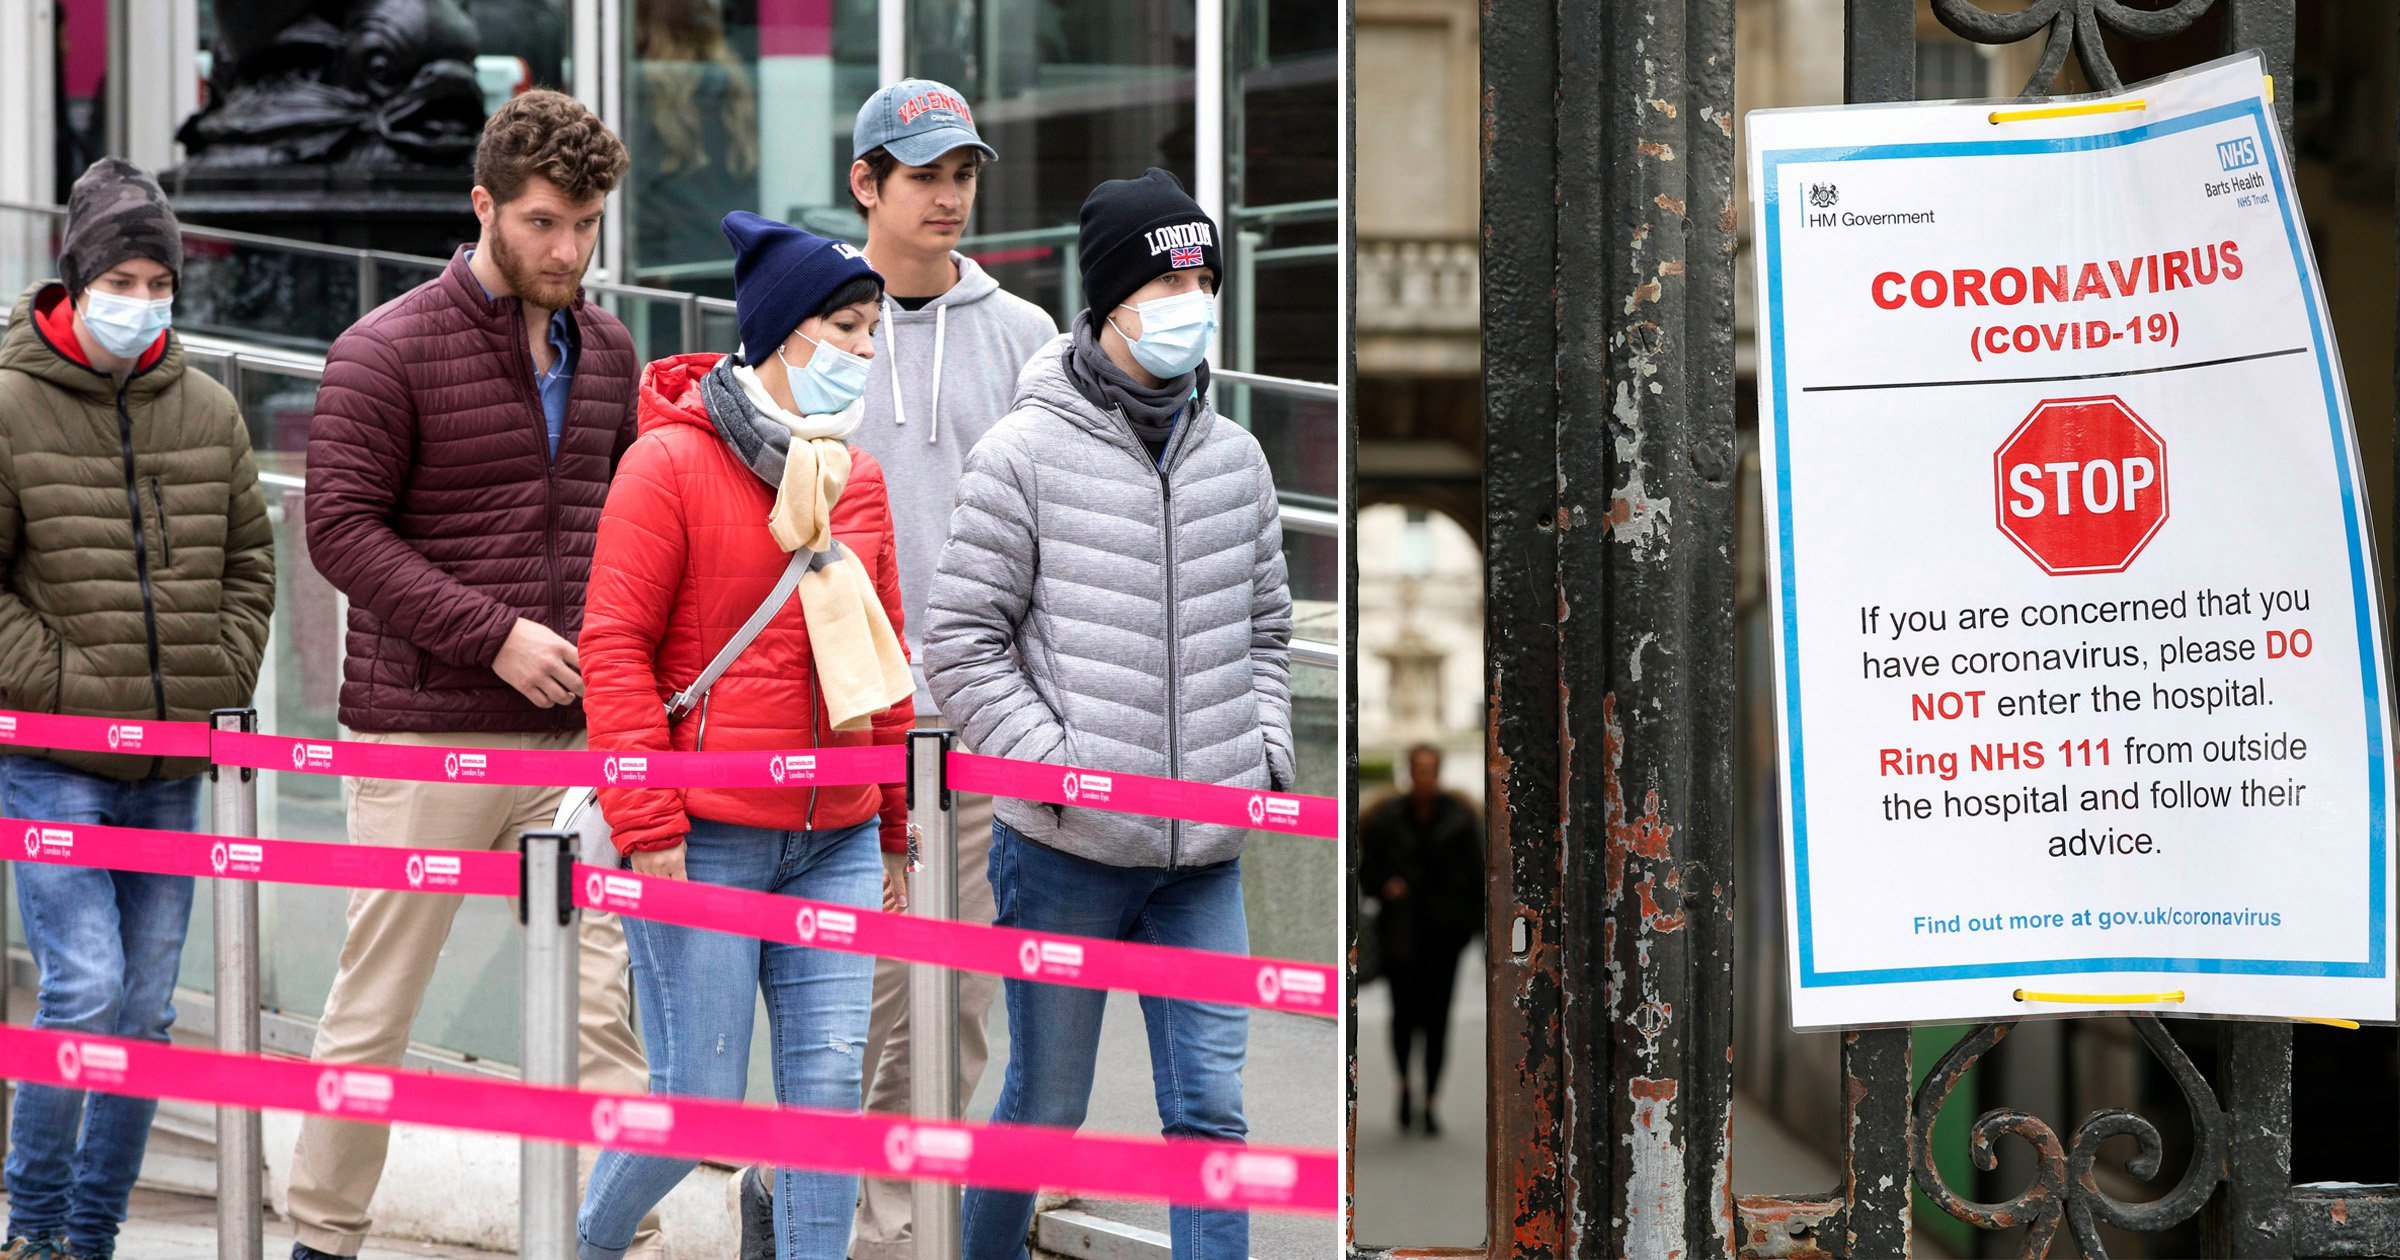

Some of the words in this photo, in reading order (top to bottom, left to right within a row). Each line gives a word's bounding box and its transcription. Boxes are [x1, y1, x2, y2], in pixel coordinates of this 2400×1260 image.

[2219, 138, 2256, 169] NHS
[2204, 180, 2231, 198] Barts
[2231, 172, 2265, 192] Health
[2236, 195, 2252, 208] NHS
[2252, 193, 2270, 205] Trust
[1144, 221, 1213, 257] LONDON
[1810, 213, 1836, 227] HM
[1842, 210, 1935, 226] Government
[1872, 240, 2243, 310] CORONAVIRUS
[1971, 311, 2179, 362] (COVID-19)
[2009, 456, 2155, 518] STOP
[1861, 606, 1880, 634] If
[1890, 611, 1946, 640] you
[1959, 608, 2009, 629] are
[2021, 590, 2186, 626] concerned
[2197, 587, 2251, 617] that
[2260, 589, 2309, 621] you
[1863, 652, 1939, 679] have
[1952, 641, 2147, 674] coronavirus,
[2161, 636, 2255, 672] please
[2266, 629, 2312, 659] DO
[1912, 691, 1985, 721] NOT
[1998, 689, 2081, 717] enter
[2091, 685, 2140, 712] the
[2153, 677, 2273, 715] hospital.
[1880, 748, 1957, 781] Ring
[1971, 741, 2044, 771] NHS
[2059, 738, 2109, 767] 111
[2124, 737, 2192, 764] from
[2203, 732, 2306, 762] outside
[1882, 793, 1932, 821] the
[1945, 784, 2067, 822] hospital
[2081, 782, 2139, 811] and
[2150, 780, 2232, 808] follow
[2241, 778, 2306, 807] their
[2049, 827, 2160, 857] advice.
[1914, 915, 1960, 934] Find
[1968, 914, 2003, 931] out
[2010, 914, 2063, 929] more
[2072, 909, 2092, 926] at
[2099, 907, 2281, 930] gov.uk/coronavirus
